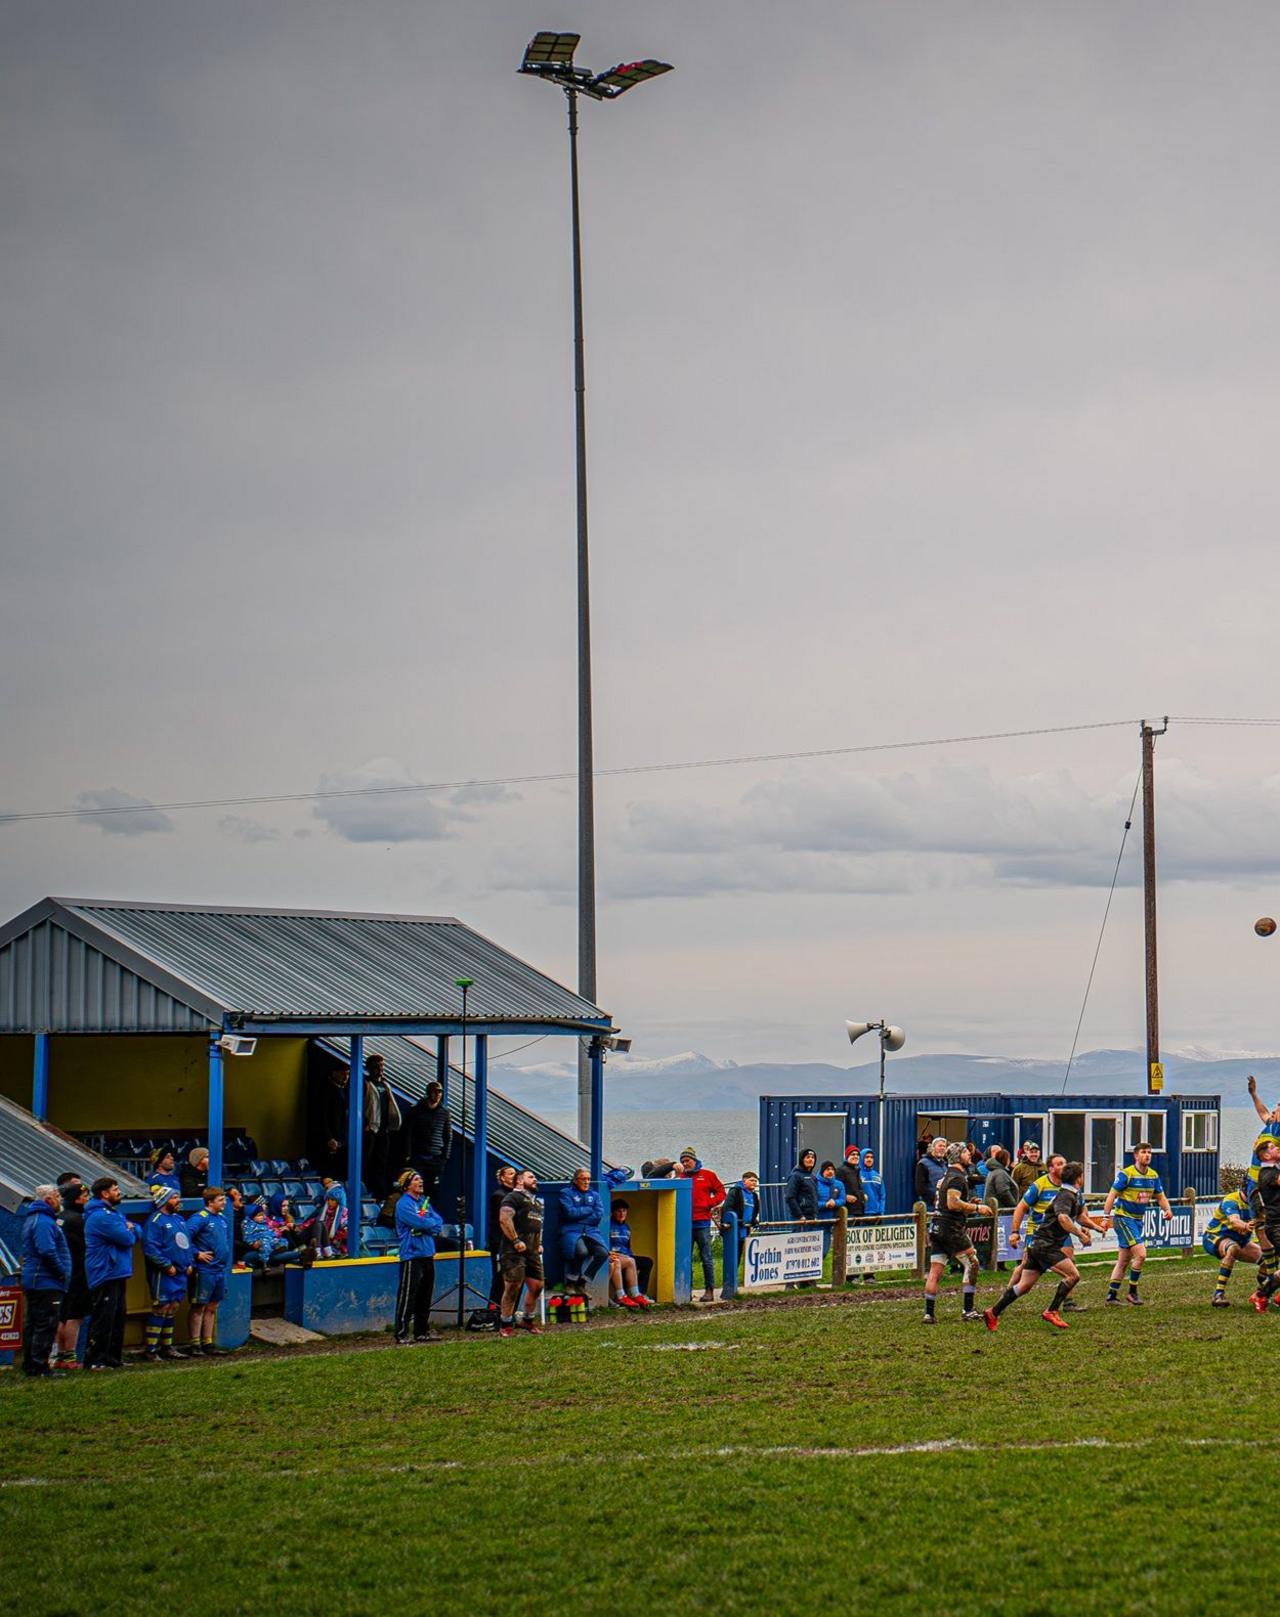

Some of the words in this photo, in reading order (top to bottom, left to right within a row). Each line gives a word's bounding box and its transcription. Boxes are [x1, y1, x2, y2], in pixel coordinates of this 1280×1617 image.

[847, 1230, 861, 1244] BOX
[862, 1228, 873, 1243] OF
[875, 1226, 915, 1242] DELIGHTS
[1158, 1210, 1190, 1241] Cymru
[748, 1238, 782, 1266] Gethin
[750, 1252, 779, 1283] Jones
